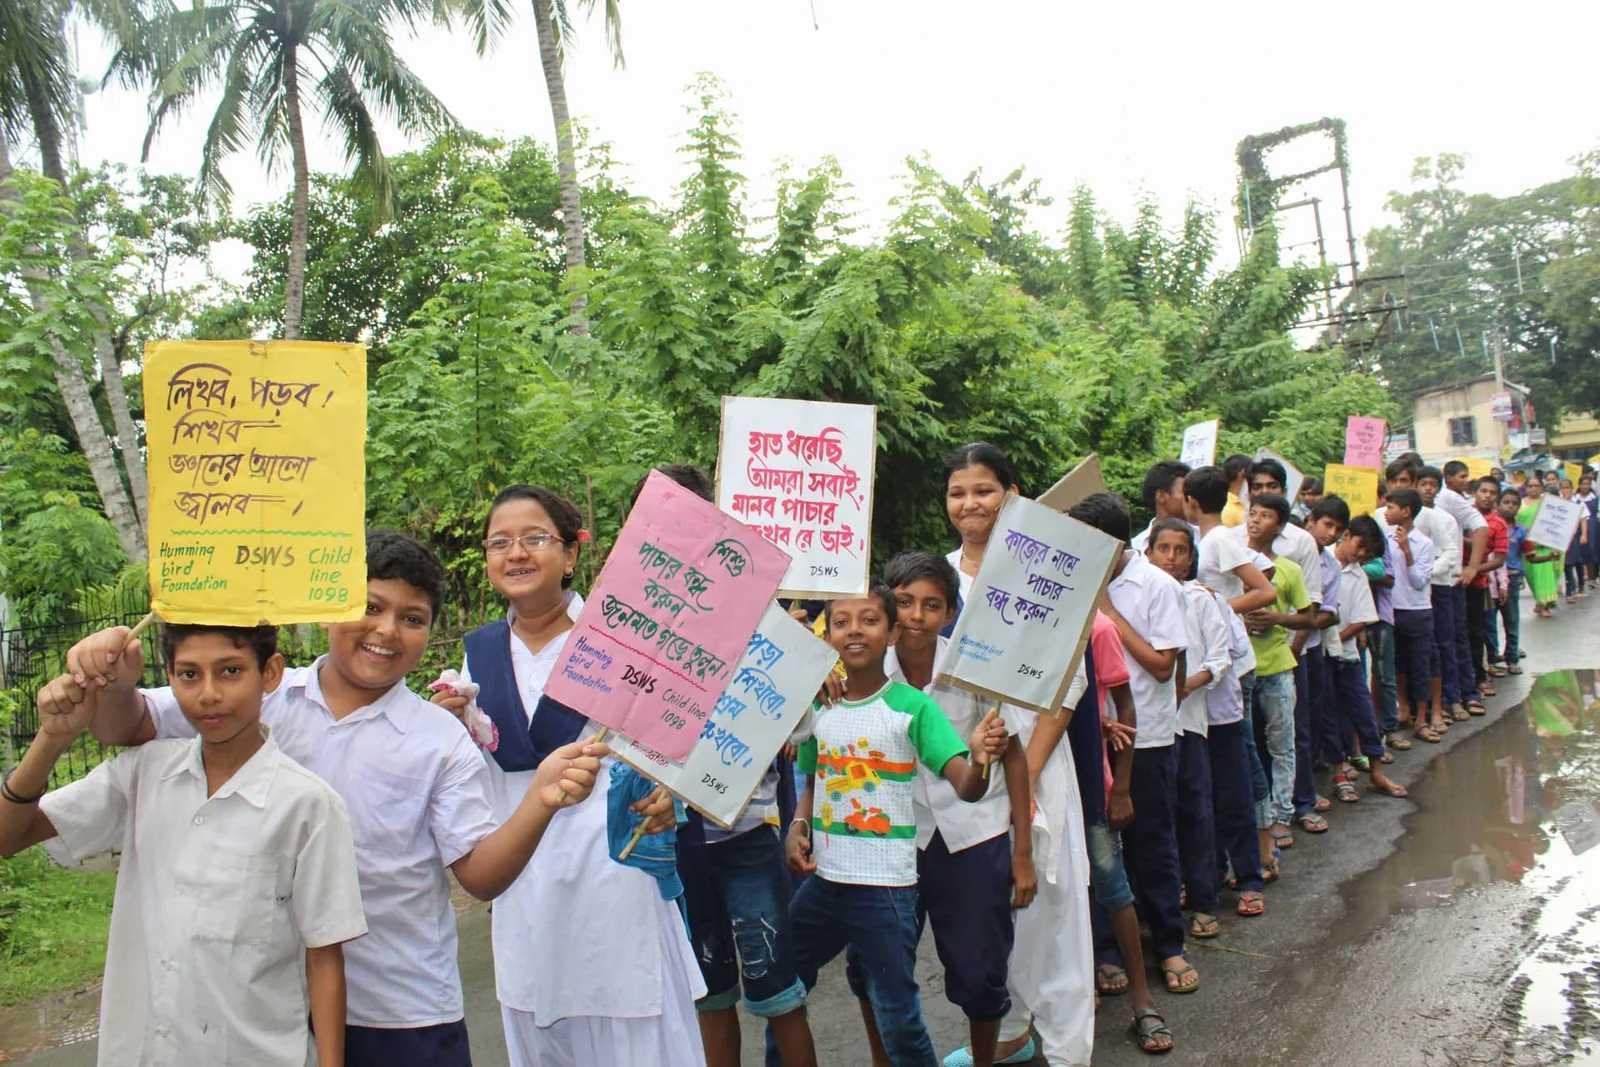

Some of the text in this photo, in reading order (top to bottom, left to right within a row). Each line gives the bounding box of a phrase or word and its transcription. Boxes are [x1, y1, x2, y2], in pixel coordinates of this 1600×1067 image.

[748, 426, 848, 468] হাত ধরেছি
[169, 447, 318, 486] জ্ঞানের আলো
[747, 458, 804, 496] আমরা
[731, 493, 839, 526] মানব পাচার
[159, 541, 216, 565] Humming
[796, 529, 815, 552] রে
[1004, 528, 1081, 577] কাজের নামে
[235, 544, 297, 567] DSWS
[308, 544, 353, 566] Child
[707, 538, 754, 577] শিশু
[162, 560, 194, 577] bird
[309, 568, 342, 584] line
[638, 541, 715, 611] পাচার বন্ধ
[809, 565, 839, 577] DSWS
[161, 576, 228, 594] Foundation
[308, 587, 349, 604] 1098
[1026, 573, 1075, 601] পাচার
[985, 585, 1014, 626] বন্ধ
[569, 652, 595, 669] bird
[575, 635, 614, 670] Humming
[562, 664, 612, 694] Foundation
[620, 664, 658, 694] DSWS
[1017, 663, 1043, 679] DSWS
[662, 688, 707, 720] Child line
[660, 710, 687, 730] 1098
[702, 772, 729, 794] DSWS
